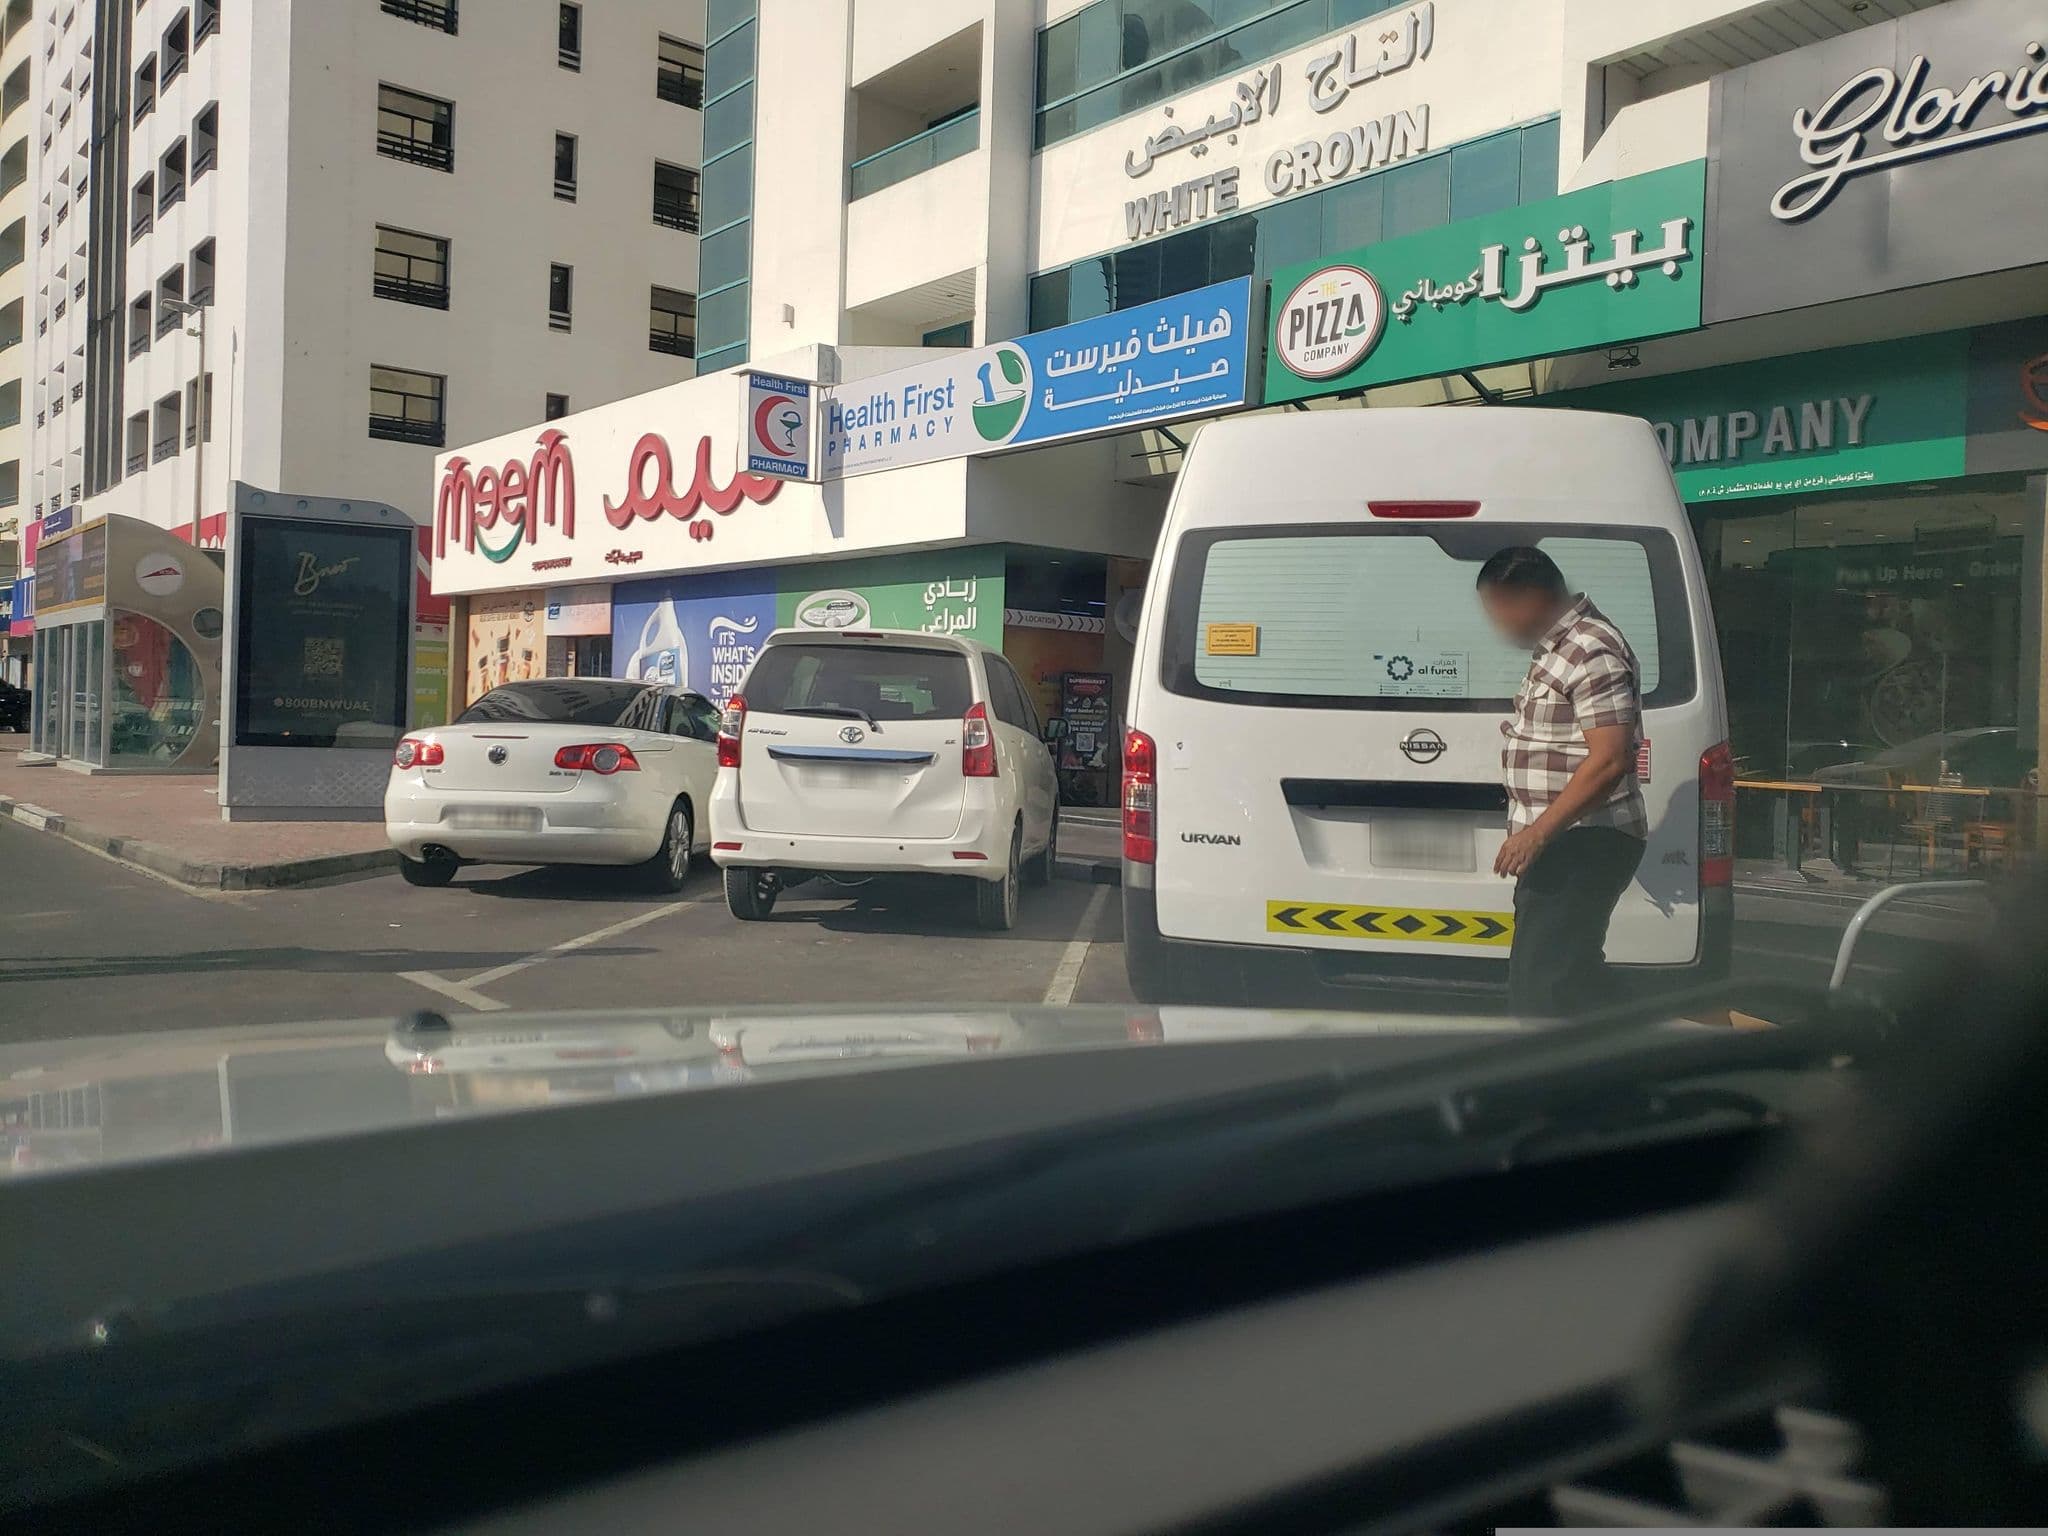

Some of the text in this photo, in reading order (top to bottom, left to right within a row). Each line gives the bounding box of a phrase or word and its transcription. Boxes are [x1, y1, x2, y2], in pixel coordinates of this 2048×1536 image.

[1305, 2, 1434, 113] التاج
[1125, 104, 1430, 240] WHITE CROWN
[1391, 217, 1693, 324] بيتزا كومباني
[1321, 281, 1337, 296] THE
[1289, 293, 1366, 351] PIZZA
[1046, 308, 1232, 378] هيلث فيرست
[1303, 343, 1349, 362] COMPANY
[752, 375, 808, 396] Health First
[1043, 356, 1229, 411] صيدلية
[829, 377, 956, 435] Health First
[828, 415, 954, 457] PHARMACY
[1654, 395, 1872, 466] OMPANY
[751, 458, 806, 476] PHARMACY
[924, 575, 977, 612] زبادي
[719, 631, 736, 645] IT'S
[712, 645, 755, 664] WHAT'S
[1418, 665, 1458, 675] al furat
[722, 685, 738, 698] TH
[1401, 742, 1445, 750] NISSAN
[1181, 832, 1241, 846] URVAN
